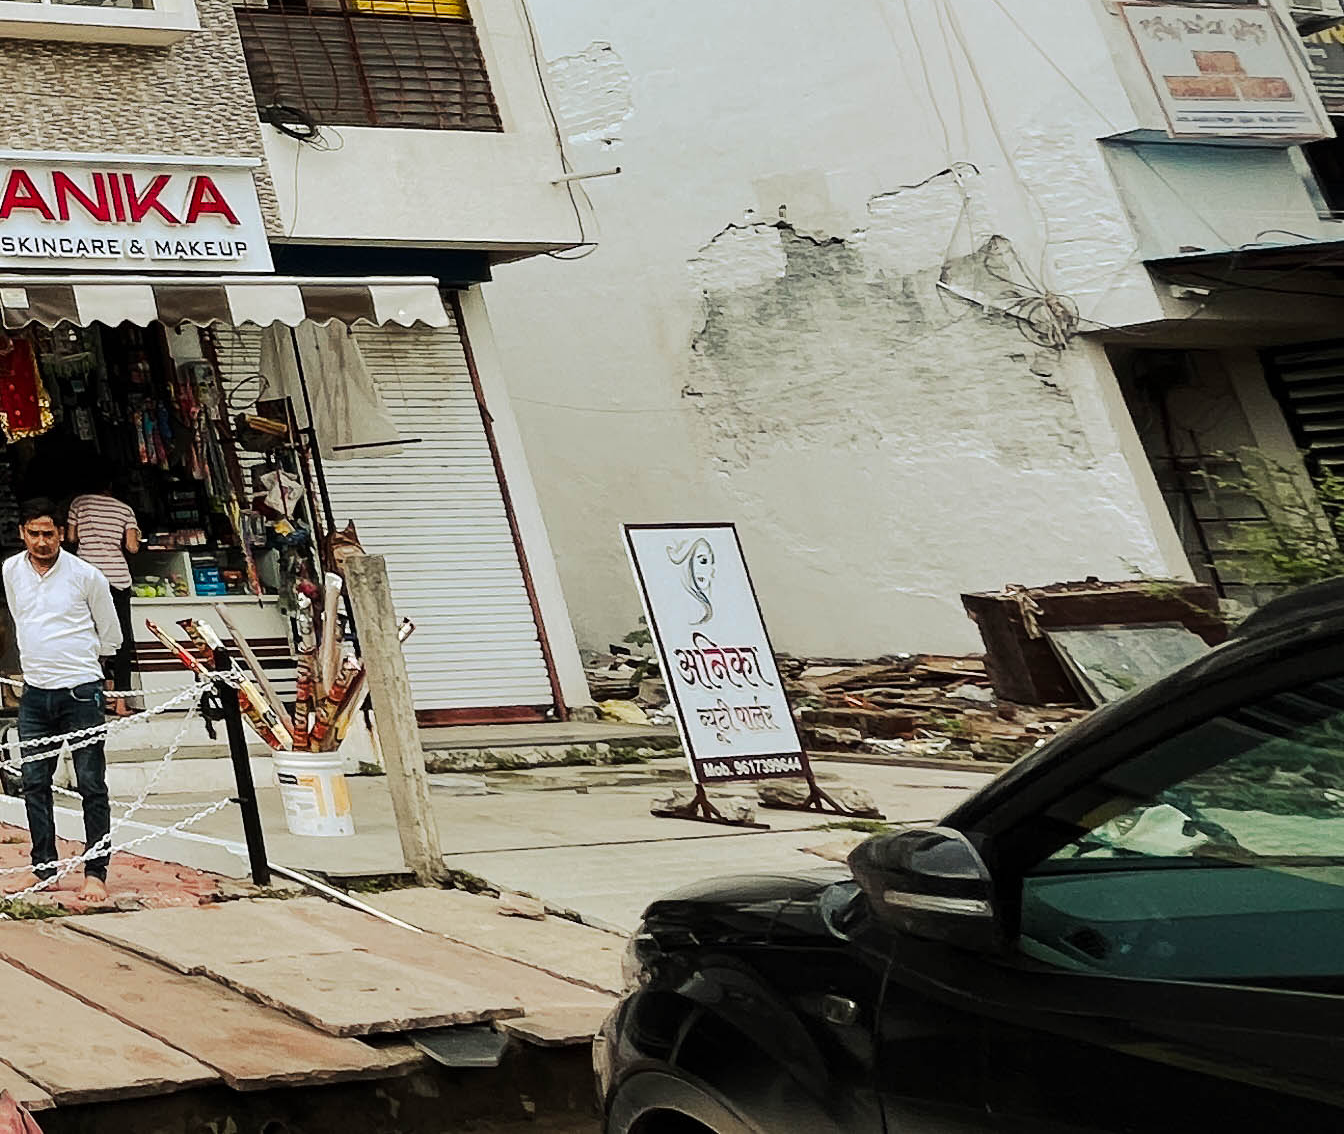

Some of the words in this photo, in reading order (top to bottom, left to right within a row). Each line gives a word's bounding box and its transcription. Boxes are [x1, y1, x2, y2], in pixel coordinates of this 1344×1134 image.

[0, 236, 121, 256] SKINCARE
[129, 239, 145, 255] &
[155, 239, 248, 257] MAKEUP
[674, 632, 774, 689] अनिका
[702, 761, 733, 778] Mob.
